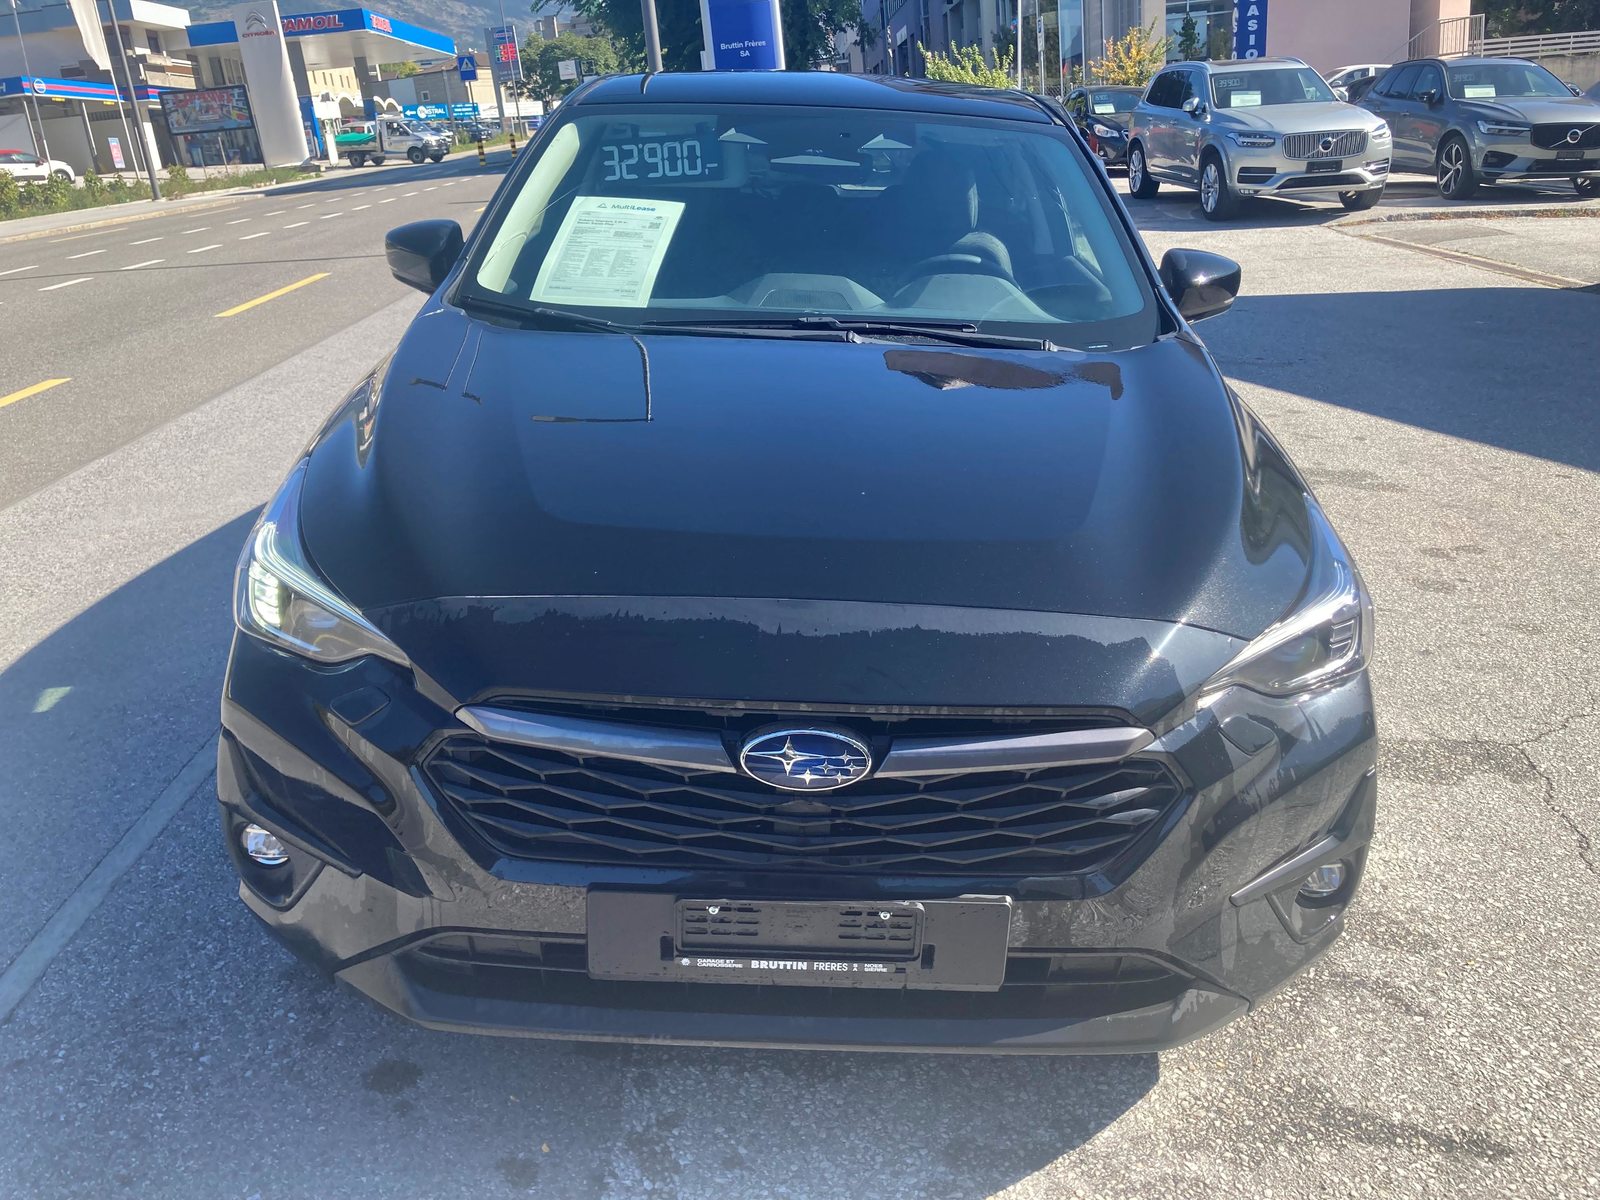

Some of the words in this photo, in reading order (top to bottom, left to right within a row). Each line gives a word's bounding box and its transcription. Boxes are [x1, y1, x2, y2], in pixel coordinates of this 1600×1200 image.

[1245, 0, 1260, 60] ASIO
[720, 42, 744, 50] Bruttin
[744, 40, 767, 48] Frères
[740, 50, 751, 58] SA
[611, 204, 656, 212] MultiLease
[751, 960, 808, 970] BRUTTIN
